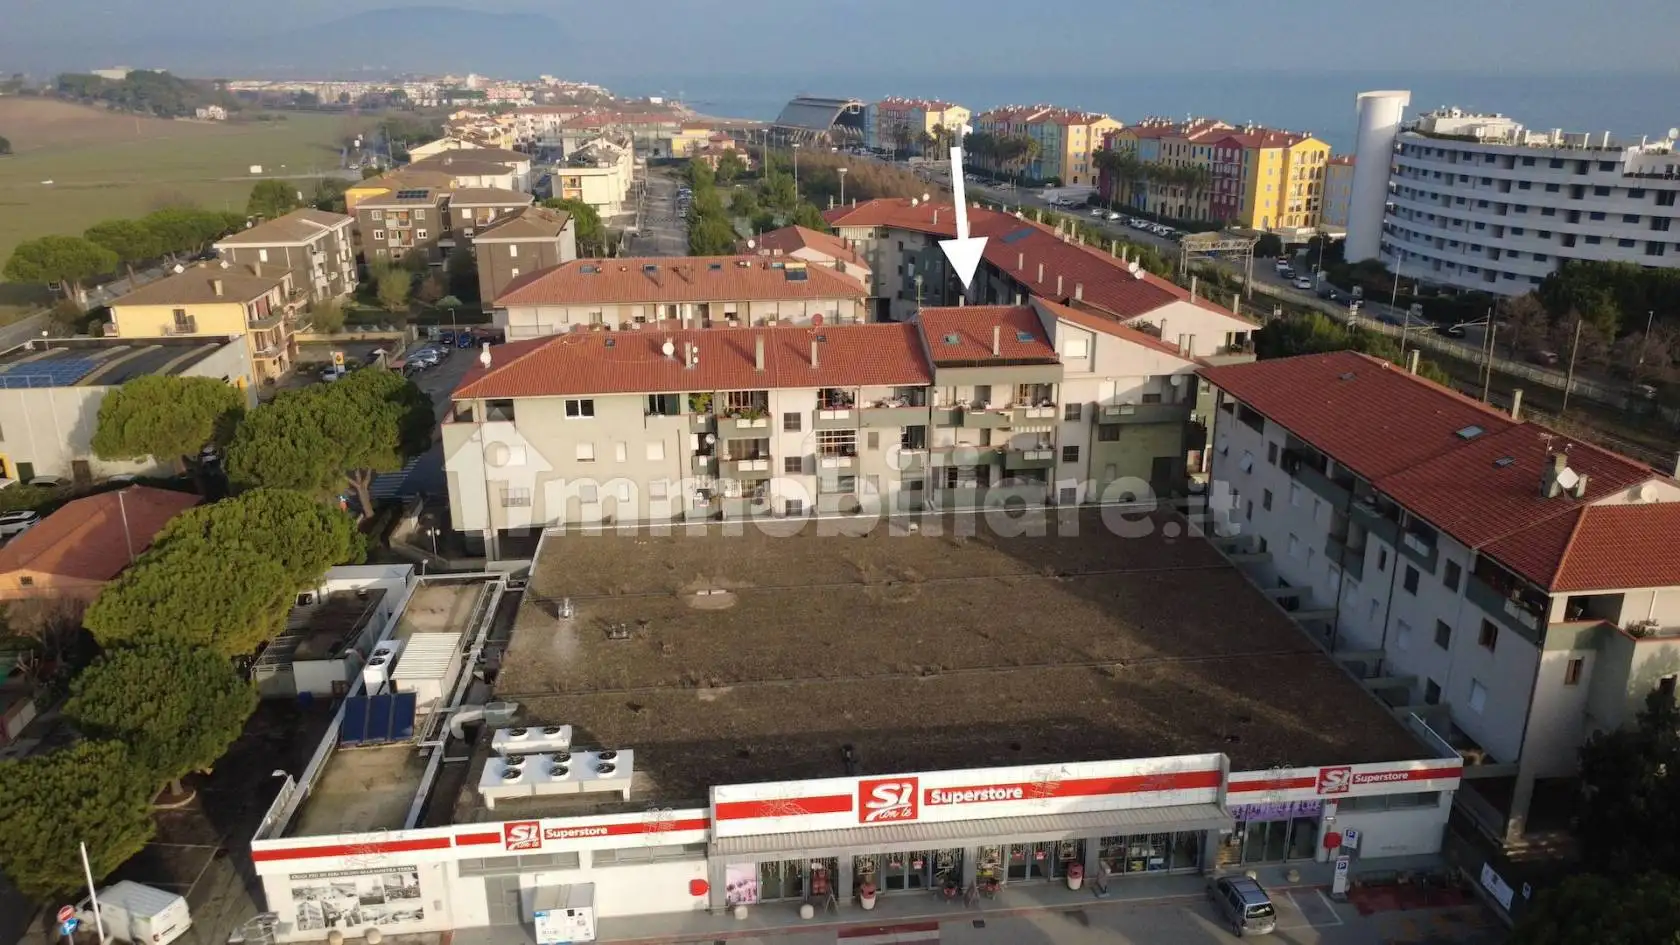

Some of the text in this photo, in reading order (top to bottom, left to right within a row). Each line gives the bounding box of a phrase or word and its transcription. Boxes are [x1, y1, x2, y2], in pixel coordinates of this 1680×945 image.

[1355, 772, 1408, 783] Superstore
[931, 786, 1023, 804] Superstore
[546, 827, 608, 839] Superstore
